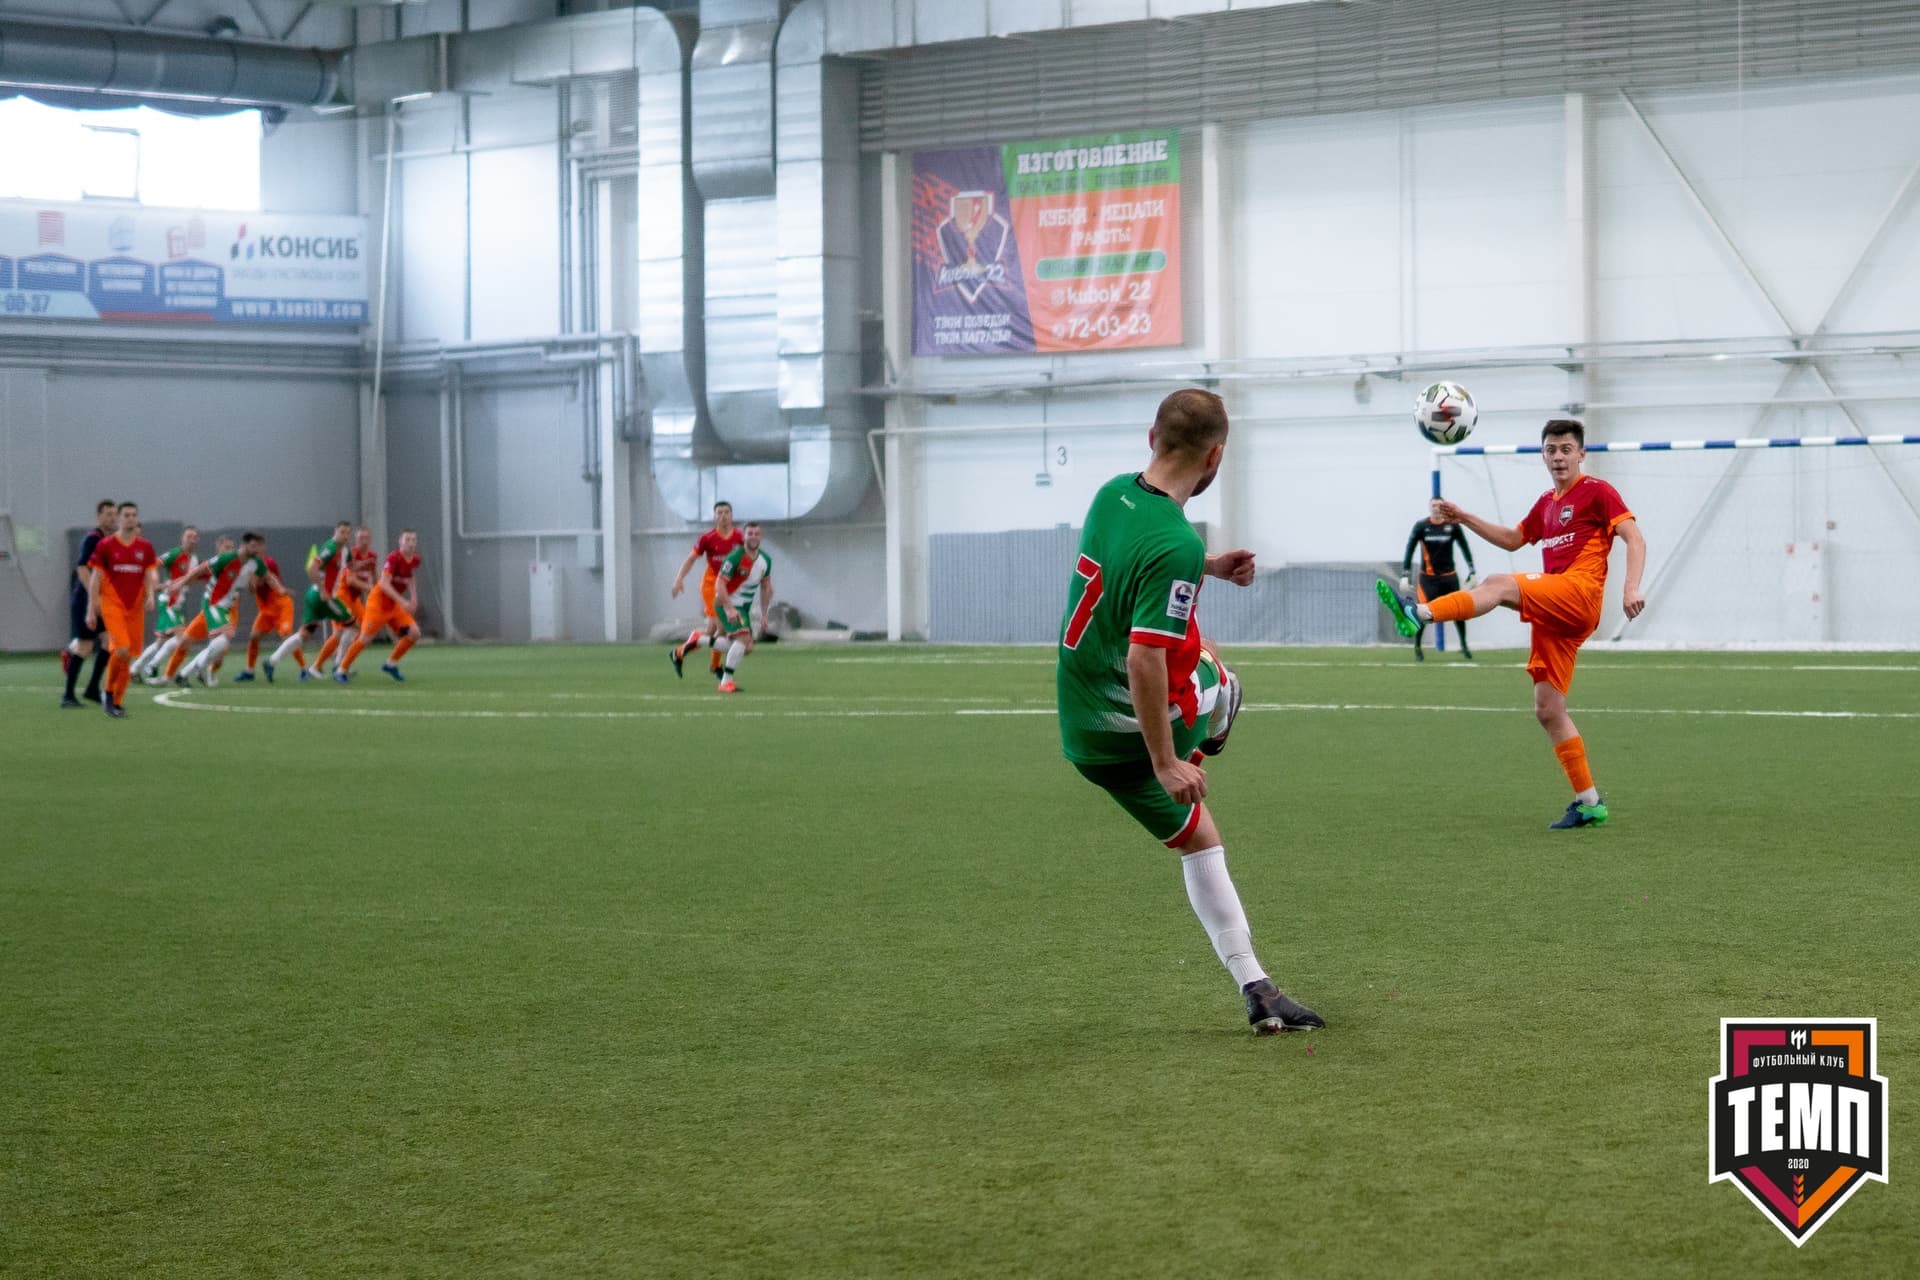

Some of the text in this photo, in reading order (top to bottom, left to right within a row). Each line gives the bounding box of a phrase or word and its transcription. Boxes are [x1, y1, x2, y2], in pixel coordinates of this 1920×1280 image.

[1016, 139, 1169, 175] ИЗГОТОВЛЕНИЕ
[260, 234, 359, 261] КОНСИБ
[1057, 446, 1067, 466] 3
[1063, 553, 1104, 650] 7
